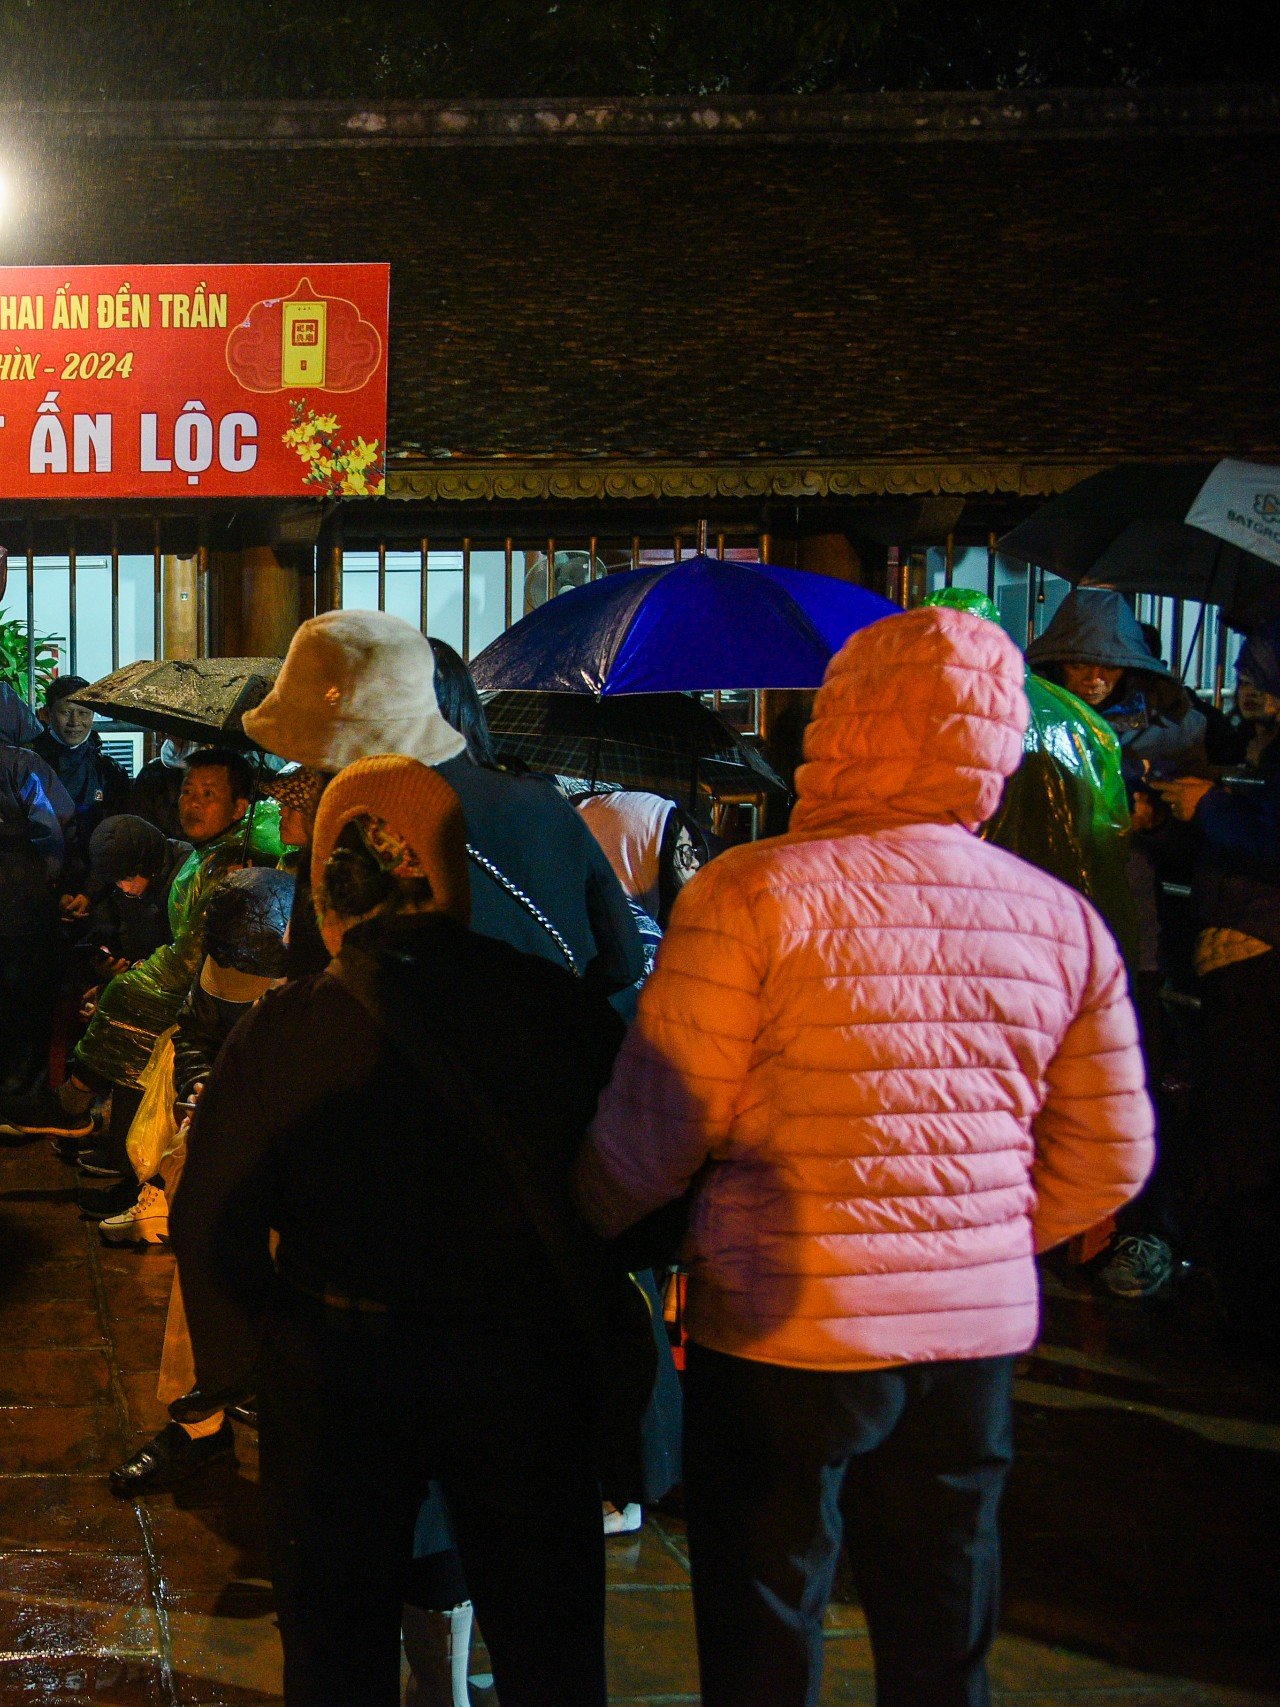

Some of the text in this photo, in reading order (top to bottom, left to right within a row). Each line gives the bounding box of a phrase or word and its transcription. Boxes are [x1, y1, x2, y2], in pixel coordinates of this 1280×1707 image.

[51, 282, 89, 330] ẤN
[97, 282, 150, 329] ĐỀN
[158, 282, 228, 329] TRẦN
[60, 351, 134, 381] 2024
[29, 391, 112, 474] ẤN
[140, 400, 258, 485] LỘC
